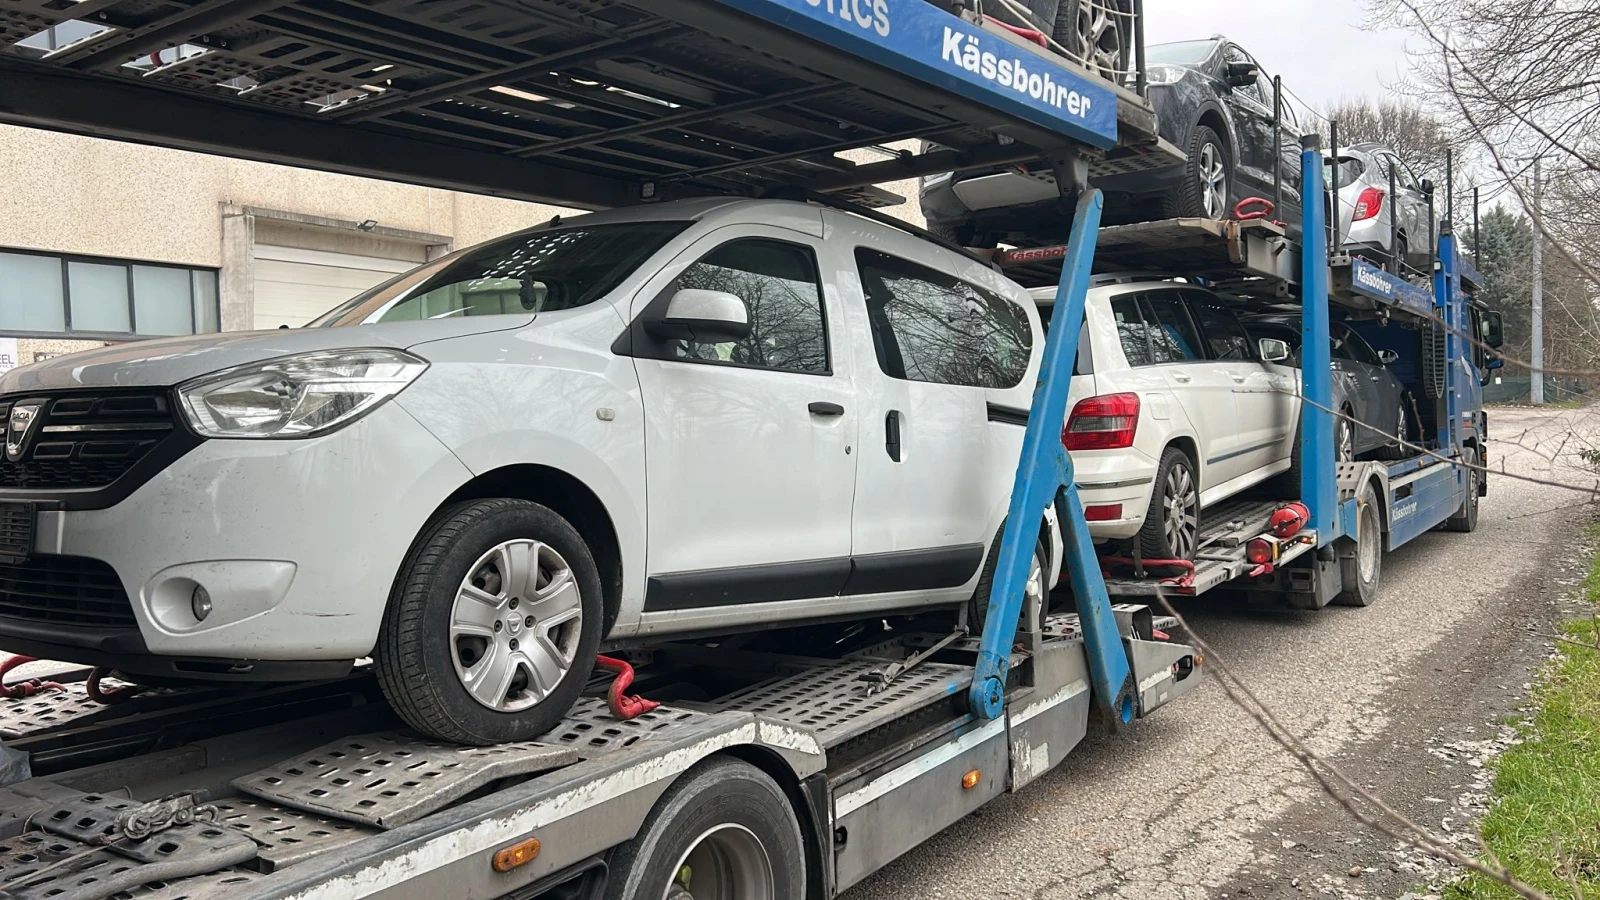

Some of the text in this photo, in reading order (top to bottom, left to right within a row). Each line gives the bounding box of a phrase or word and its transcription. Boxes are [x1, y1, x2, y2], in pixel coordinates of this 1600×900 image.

[942, 26, 1091, 118] Kässbohrer
[1008, 245, 1068, 261] Kässboh
[1357, 265, 1392, 294] Kässbohrer
[0, 354, 15, 364] EL
[12, 412, 30, 420] DACIA
